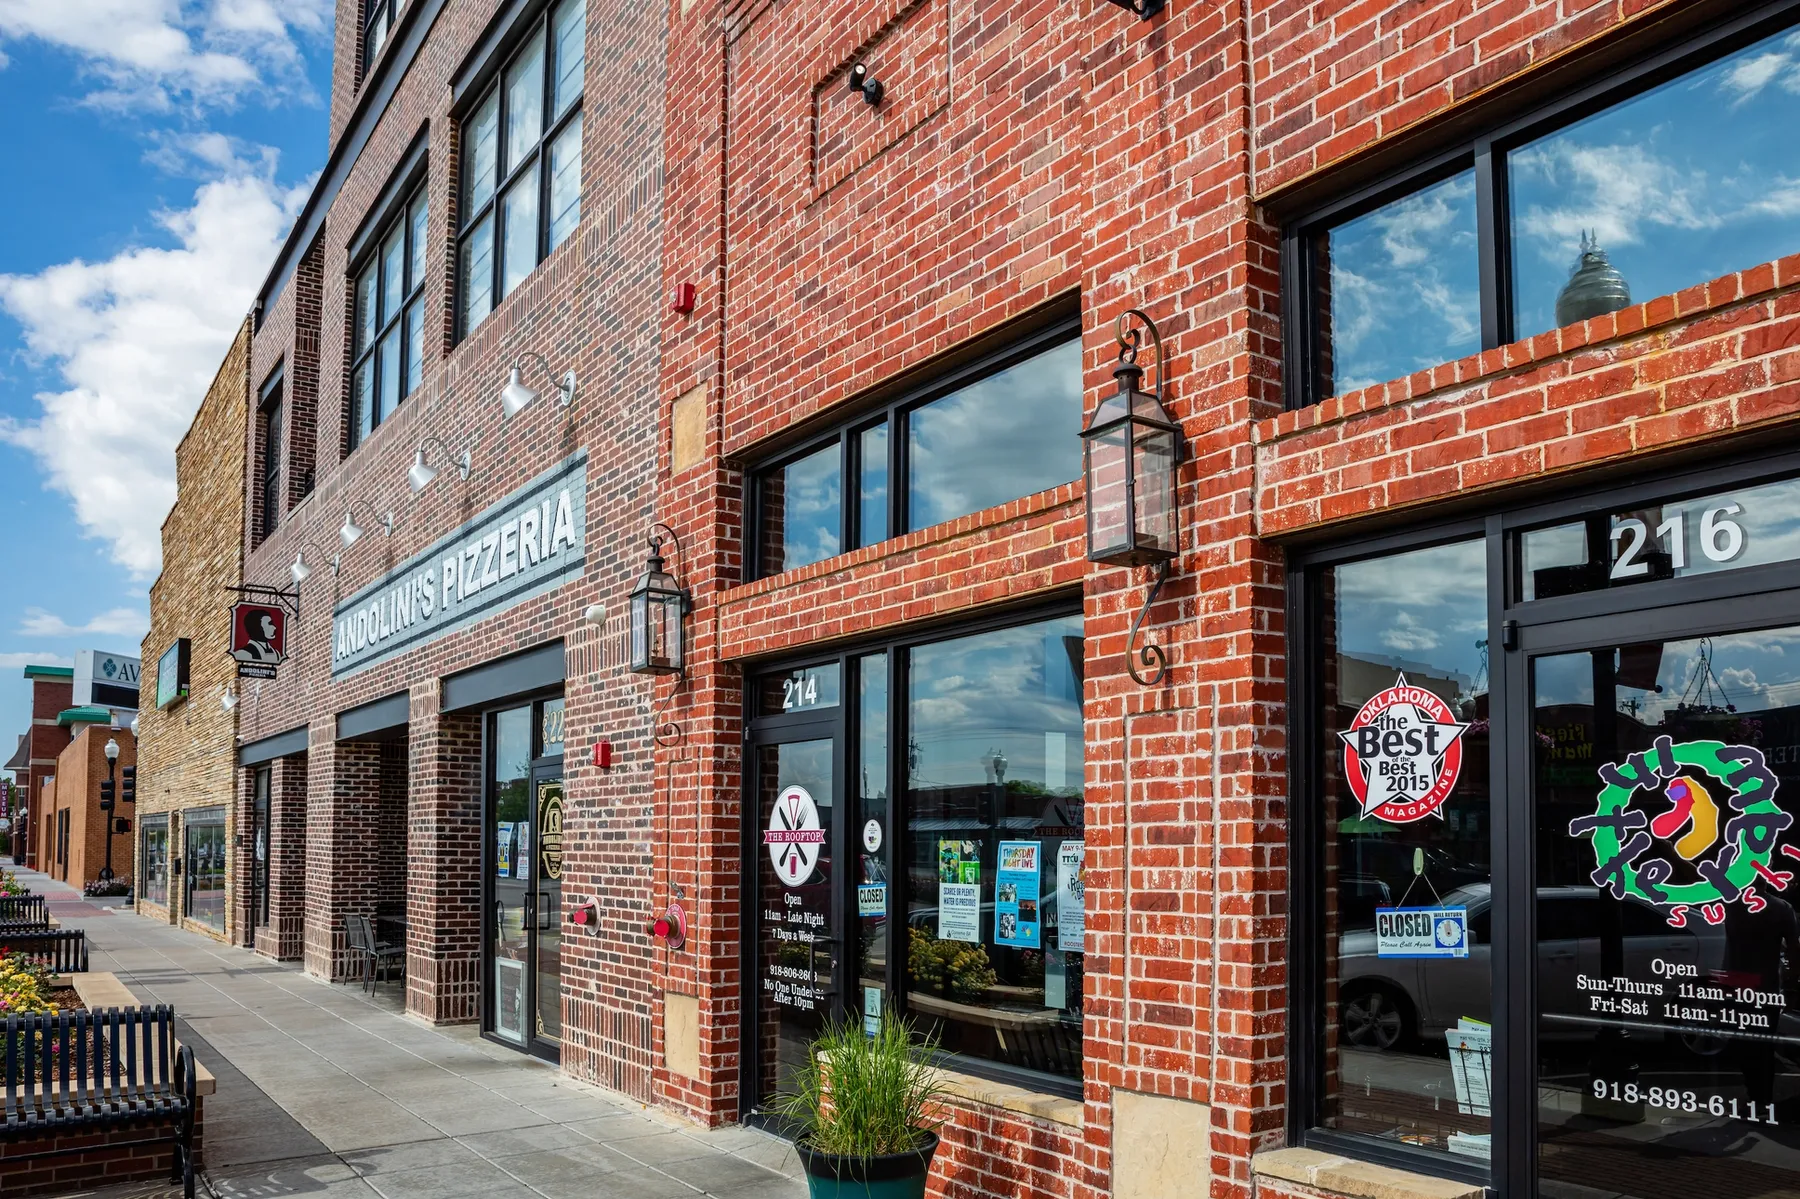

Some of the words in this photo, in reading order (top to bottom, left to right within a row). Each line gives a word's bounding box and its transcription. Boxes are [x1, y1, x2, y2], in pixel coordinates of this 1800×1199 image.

[1609, 500, 1743, 580] 216
[336, 568, 436, 662] ANDOLINI'S
[442, 488, 577, 611] PIZZERIA
[783, 674, 817, 709] 214
[1360, 689, 1444, 723] OKLAHOMA
[1379, 715, 1408, 731] the
[1358, 725, 1440, 759] Best
[1379, 761, 1417, 776] Best
[1384, 768, 1453, 817] MAGAZINE
[1386, 775, 1430, 792] 2015
[769, 832, 783, 841] THE
[785, 831, 821, 841] ROOFTOP
[1003, 847, 1035, 859] THURSDAY
[784, 892, 802, 907] Open
[860, 888, 883, 903] CLOSED
[764, 908, 781, 921] 11am
[788, 911, 803, 923] Late
[803, 912, 824, 928] Night
[1379, 913, 1432, 937] CLOSED
[772, 928, 777, 938] 7
[777, 928, 792, 942] Days
[793, 932, 798, 940] a
[798, 930, 815, 942] Week
[1651, 958, 1698, 979] Open
[764, 978, 774, 991] No
[775, 980, 790, 994] One
[791, 983, 813, 998] Under
[1577, 974, 1663, 996] Sun-Thurs
[773, 991, 792, 1005] After
[794, 996, 814, 1011] 10pm
[1590, 996, 1648, 1016] Fri-Sat
[1593, 1079, 1779, 1125] 918-893-6111
